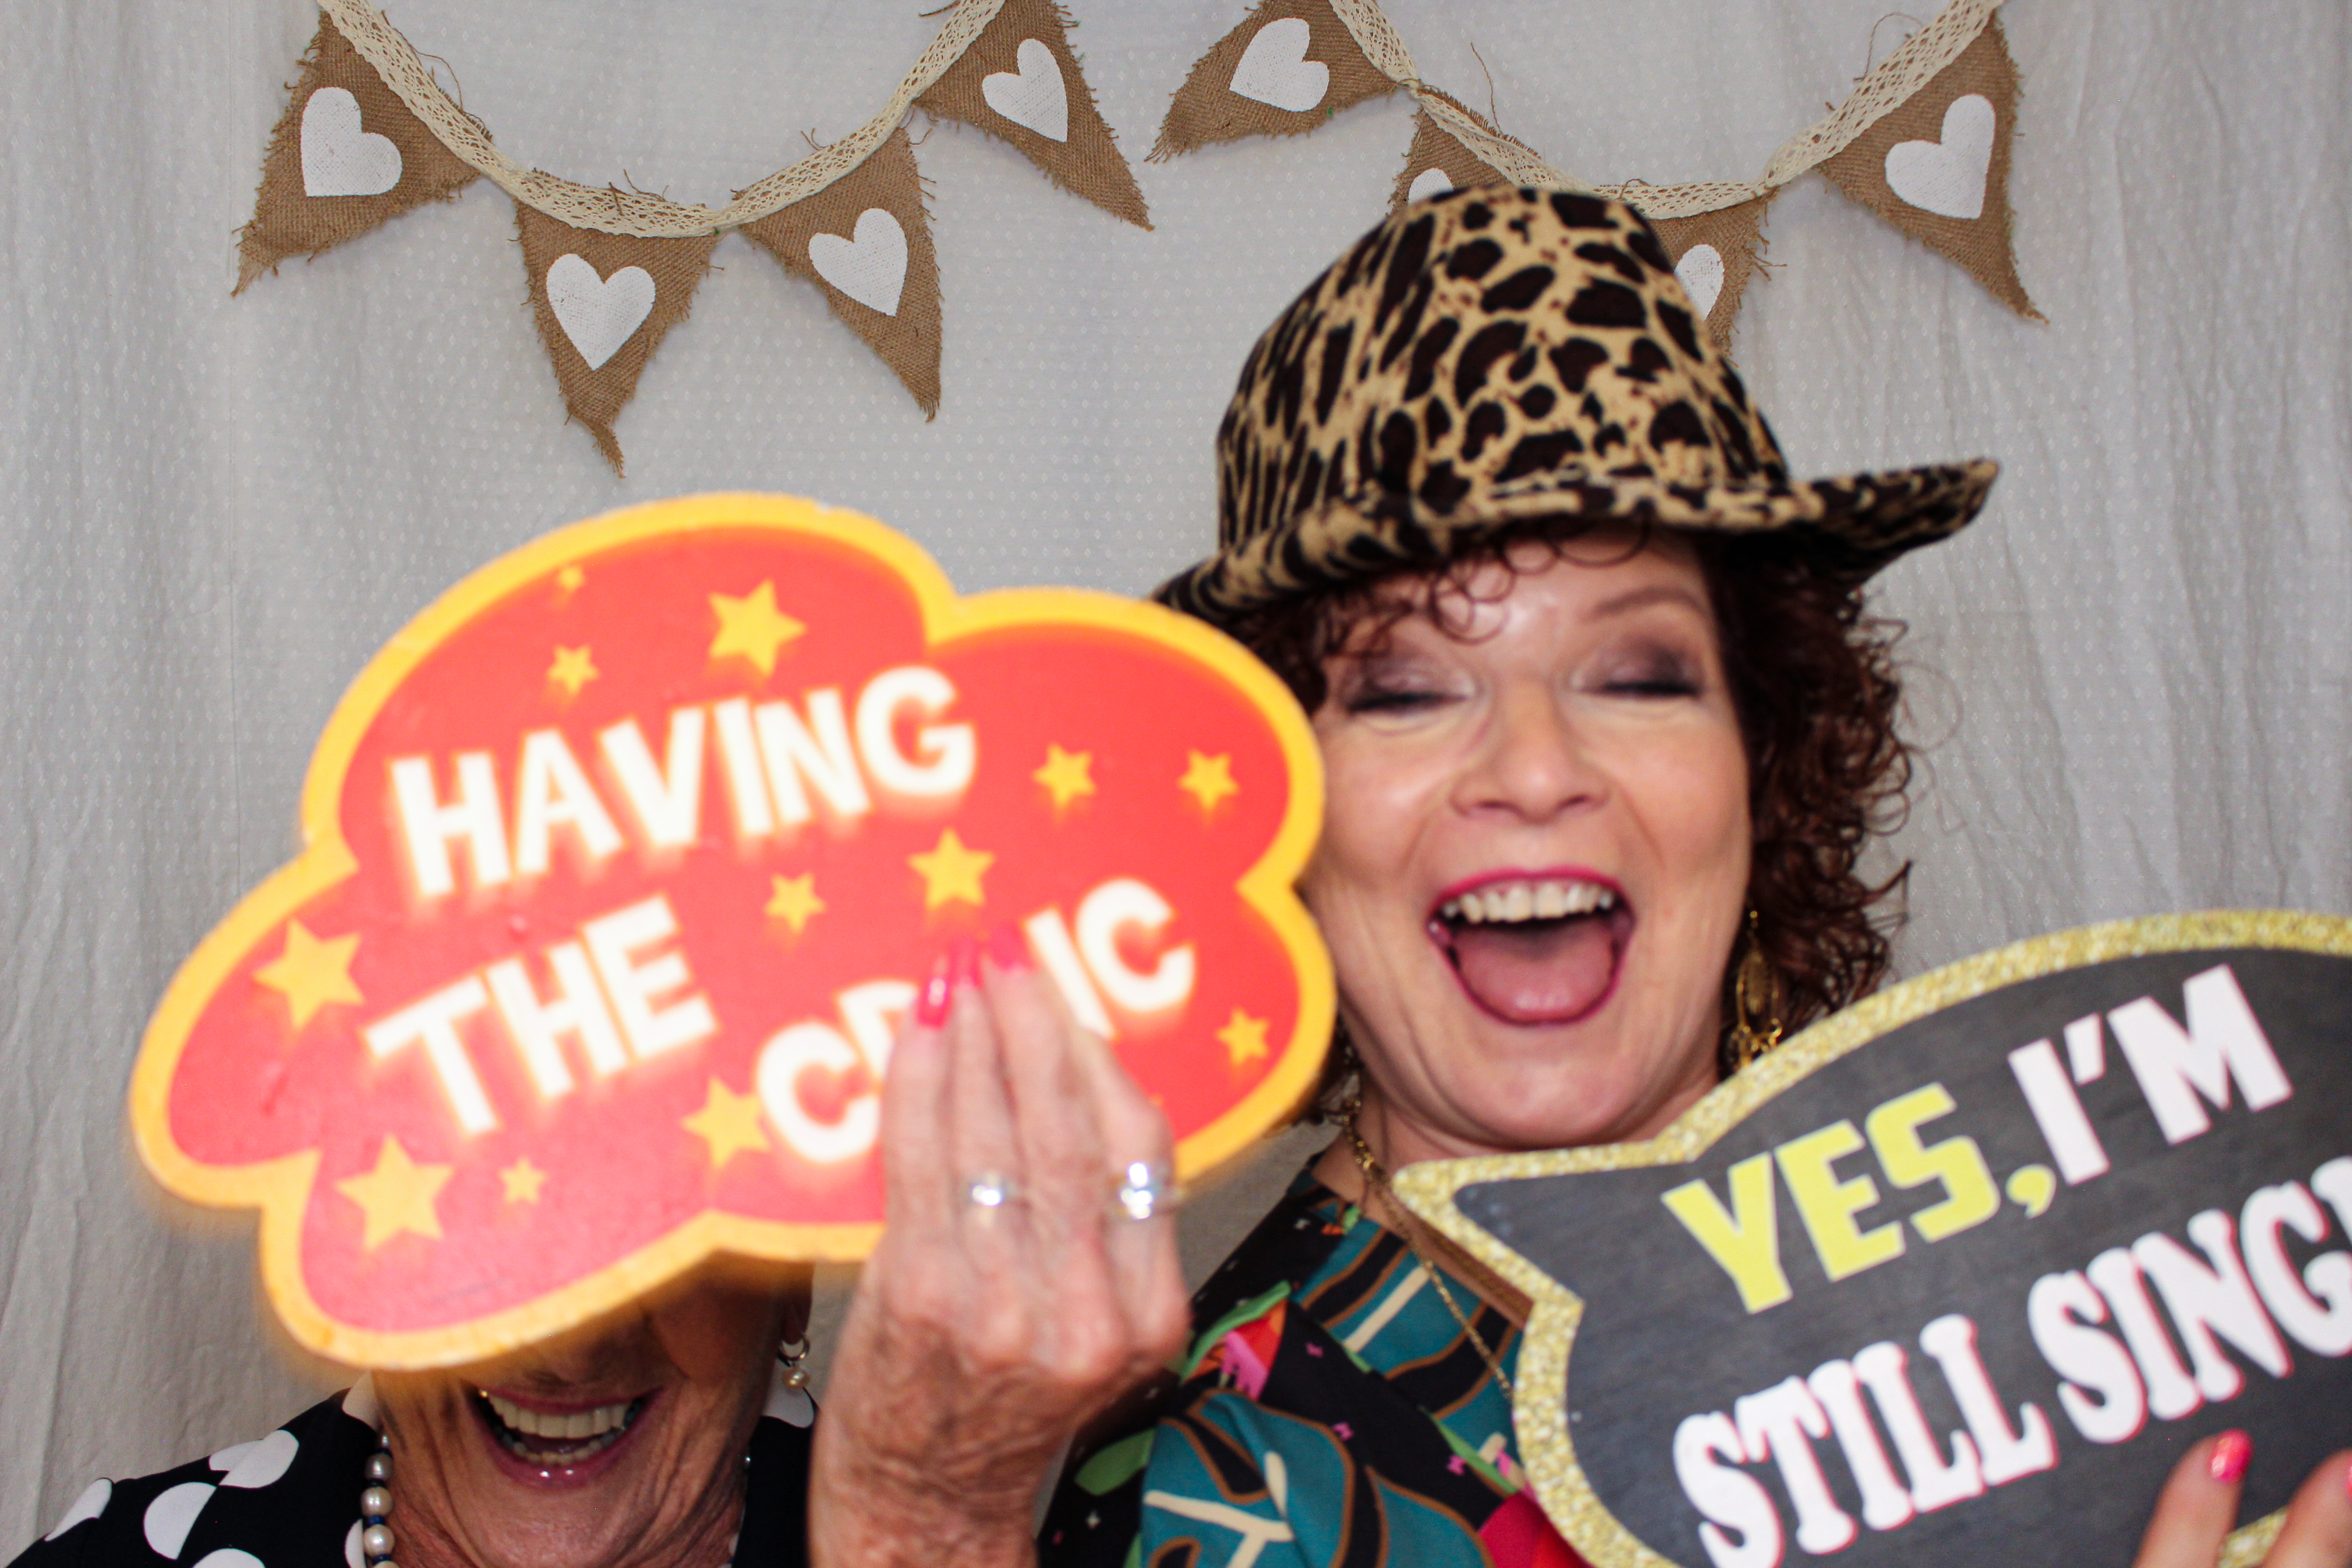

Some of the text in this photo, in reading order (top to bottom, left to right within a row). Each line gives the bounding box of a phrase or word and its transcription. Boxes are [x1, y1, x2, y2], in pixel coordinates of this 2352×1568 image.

[388, 664, 978, 898] HAVING
[362, 877, 1196, 1164] THE CIC
[2008, 963, 2294, 1186] I'M
[1672, 1155, 2352, 1568] STILL SING
